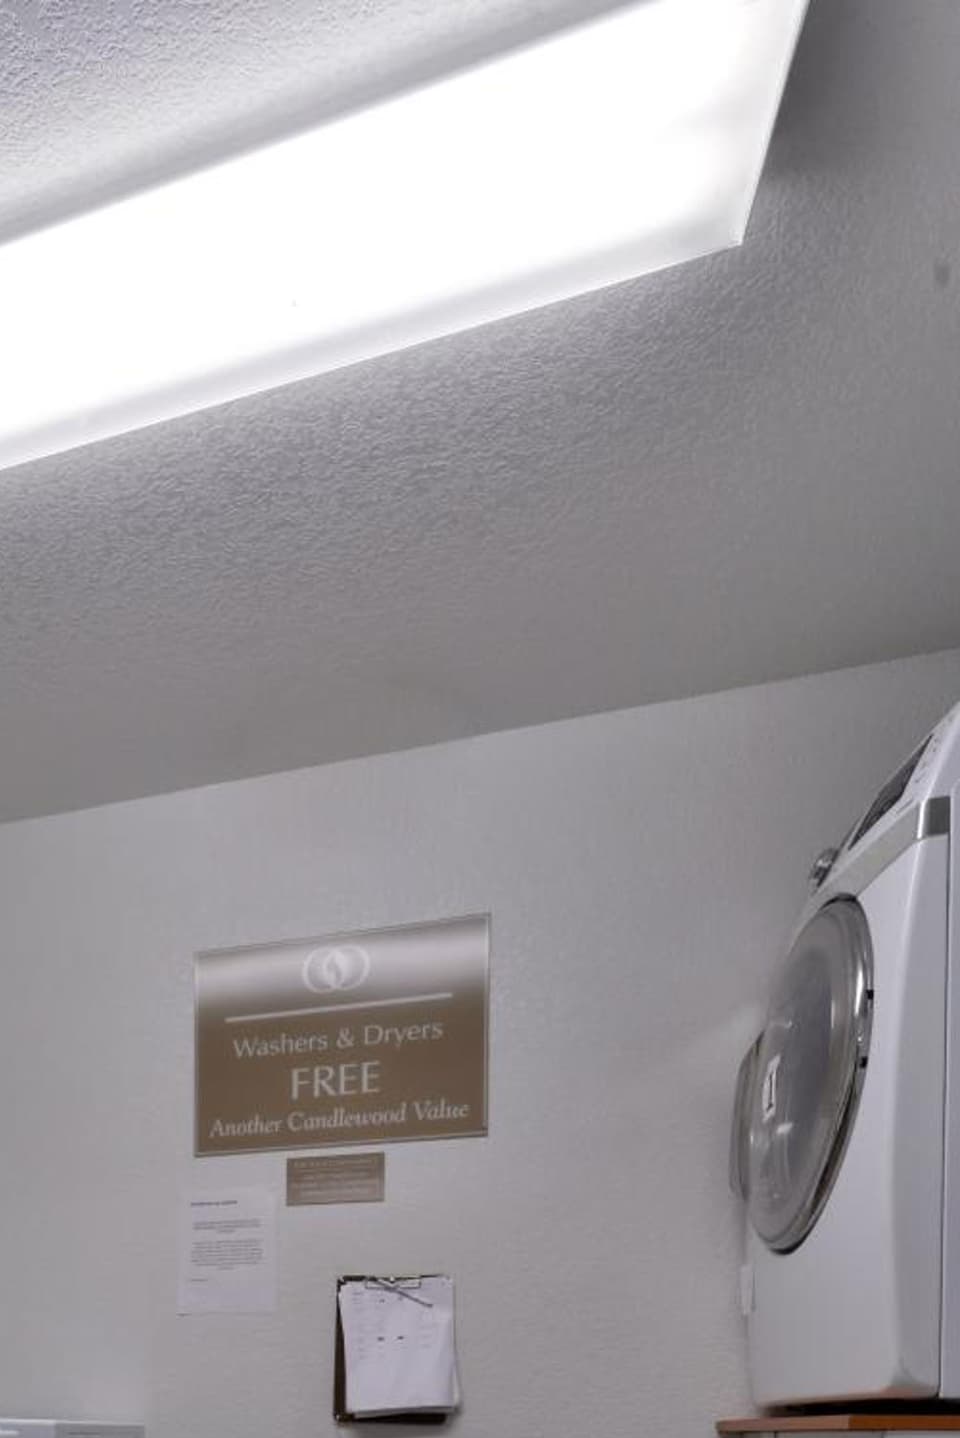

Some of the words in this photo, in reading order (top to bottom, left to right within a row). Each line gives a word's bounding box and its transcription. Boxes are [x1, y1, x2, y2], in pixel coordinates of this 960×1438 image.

[232, 1033, 328, 1057] Washers
[336, 1027, 355, 1048] &
[363, 1022, 443, 1048] Dryers
[290, 1061, 380, 1100] FREE
[209, 1114, 282, 1139] Another
[286, 1103, 406, 1132] Candlewood
[414, 1099, 470, 1121] Value
